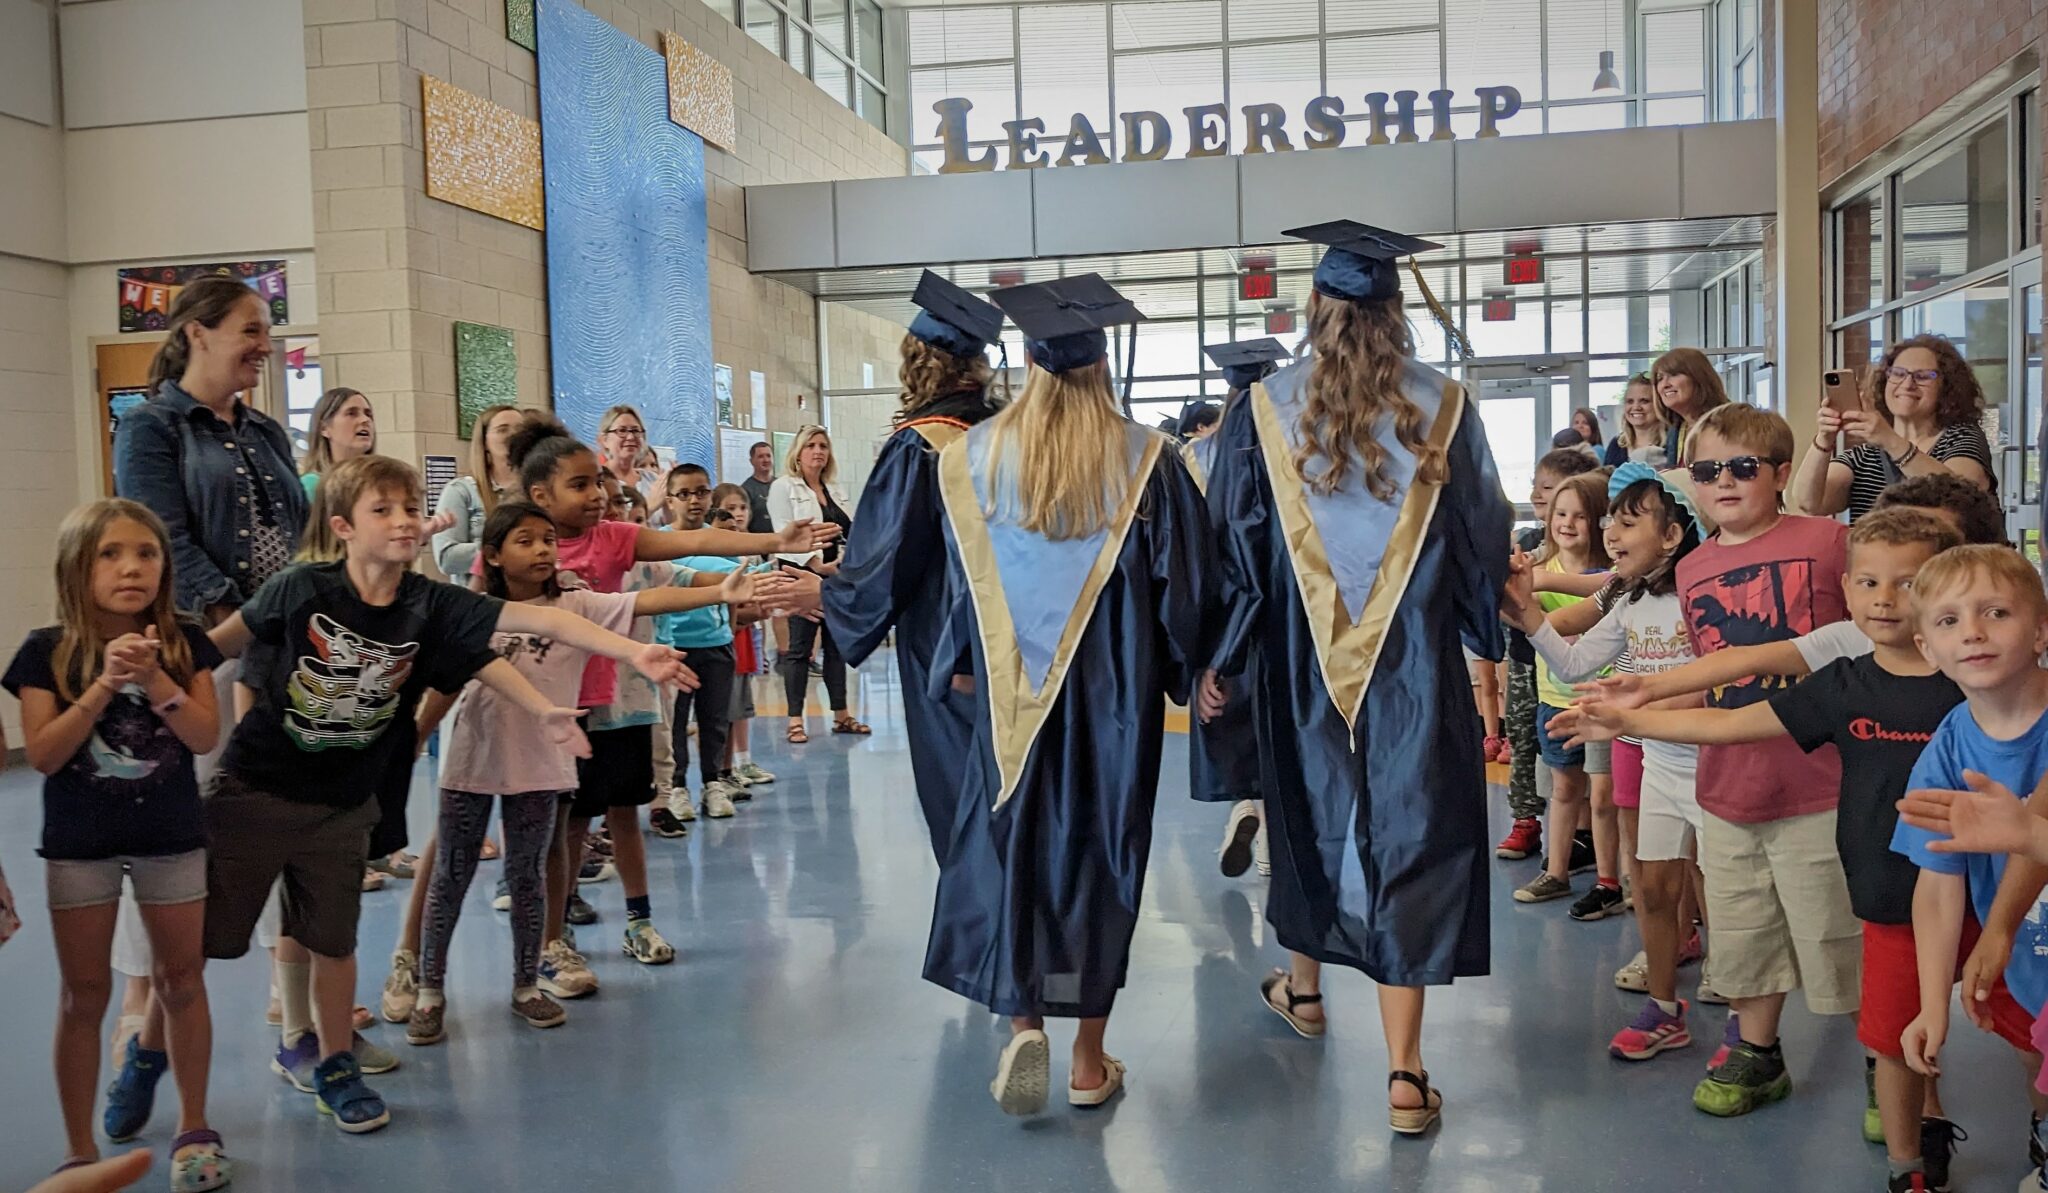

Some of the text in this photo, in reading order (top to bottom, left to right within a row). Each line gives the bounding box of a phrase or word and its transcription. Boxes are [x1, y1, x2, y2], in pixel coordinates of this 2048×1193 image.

[1511, 258, 1538, 283] EXIT
[1244, 274, 1272, 298] EXIT
[1636, 664, 1656, 673] EACH
[1849, 718, 1935, 742] Cham
